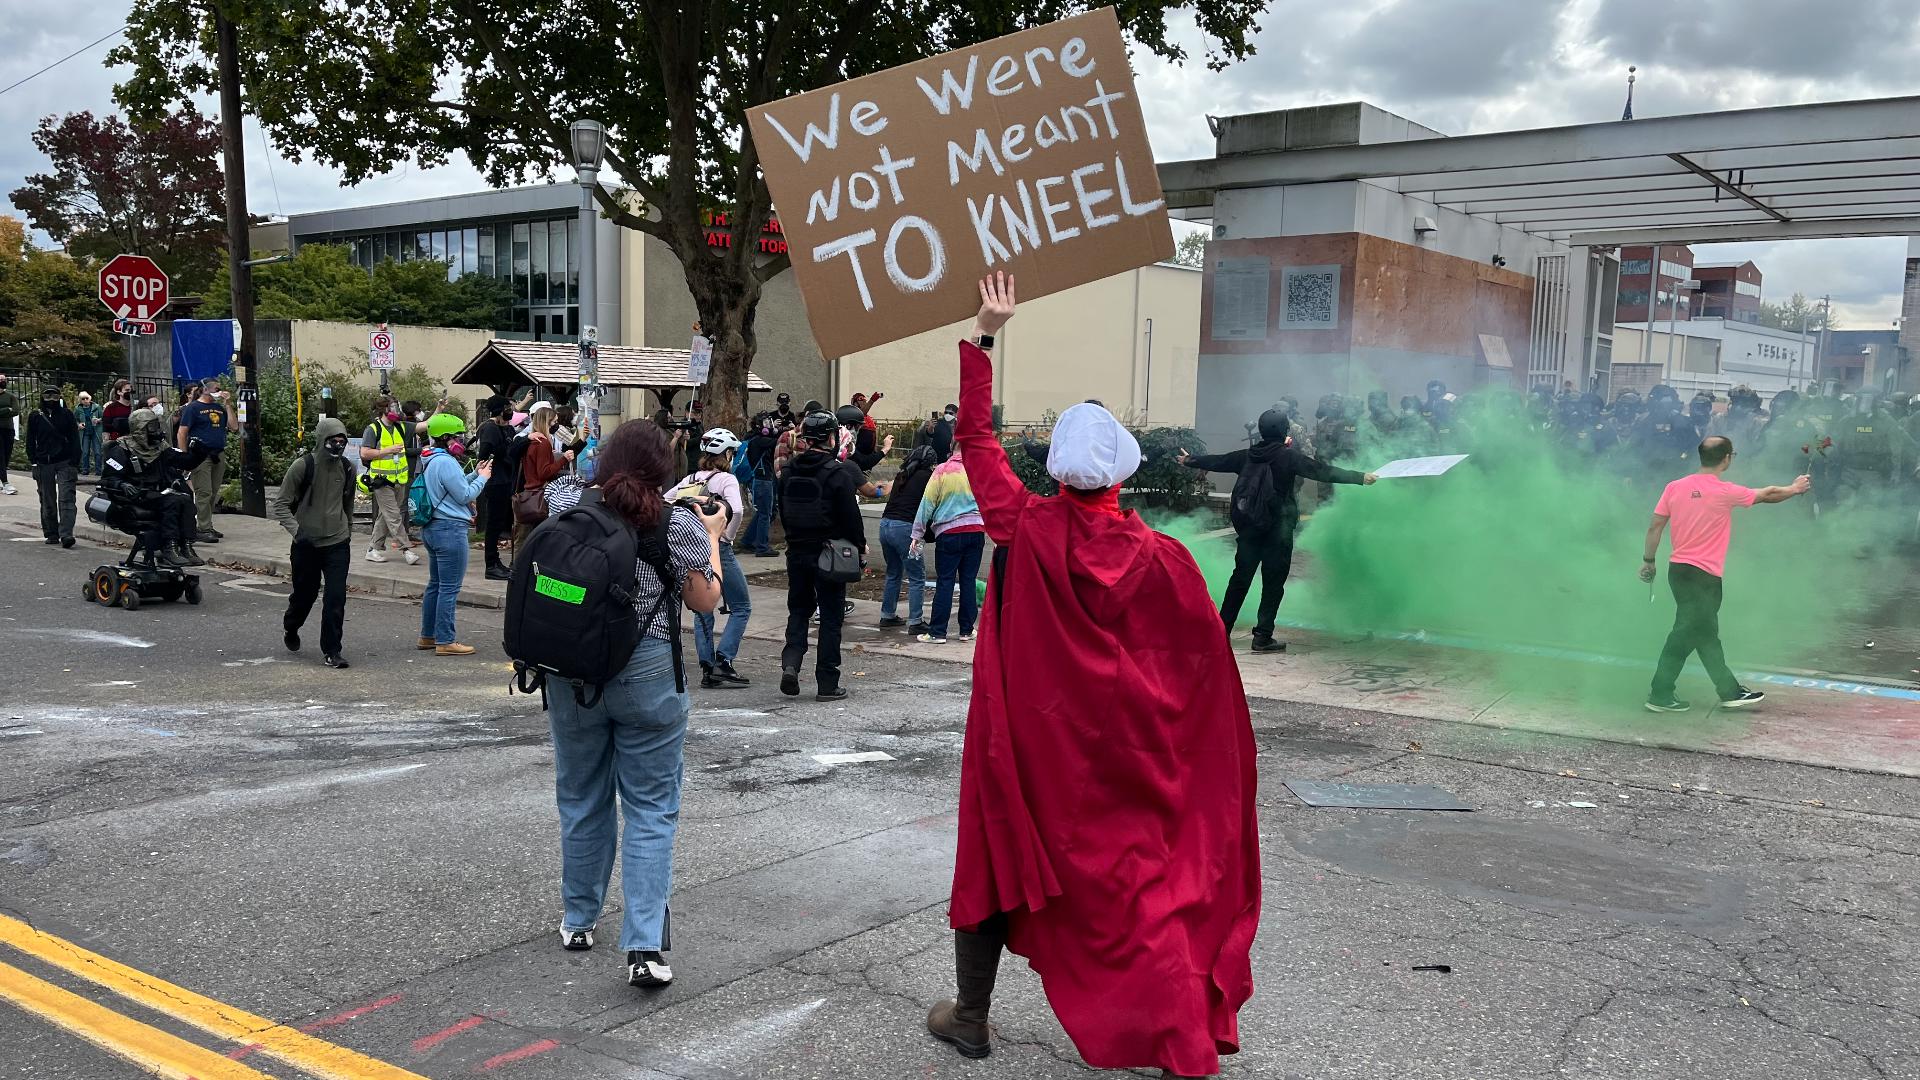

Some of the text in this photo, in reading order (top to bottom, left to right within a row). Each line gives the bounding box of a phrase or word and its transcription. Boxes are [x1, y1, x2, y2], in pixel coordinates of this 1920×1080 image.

[764, 37, 1097, 163] We Were
[948, 79, 1126, 186] Meant
[812, 151, 1164, 312] TO KNEEL
[104, 273, 164, 301] STOP
[1757, 343, 1788, 360] TESLA
[541, 578, 568, 598] PRESS
[1736, 673, 1879, 695] LOCK
